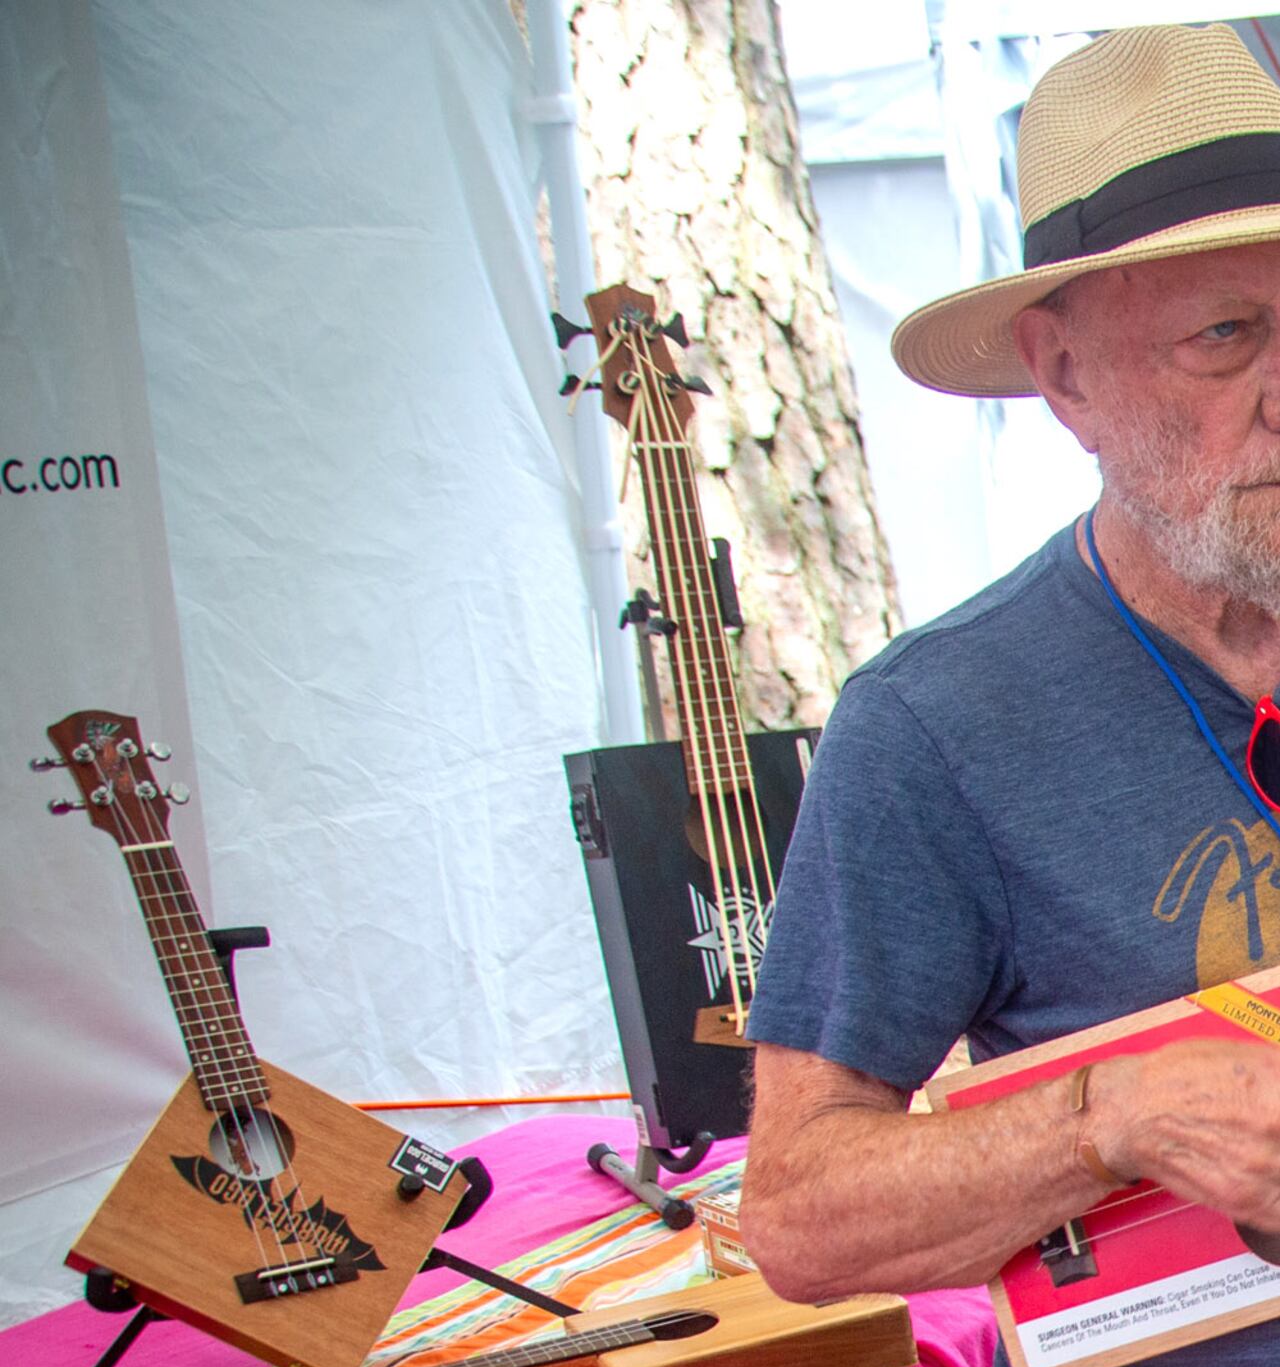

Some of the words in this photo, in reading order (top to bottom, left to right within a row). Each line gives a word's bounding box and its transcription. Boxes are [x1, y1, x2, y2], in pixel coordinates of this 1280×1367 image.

[0, 454, 119, 494] c.com
[1222, 1003, 1276, 1038] LIMITED
[1038, 1322, 1079, 1343] SURGEON
[1080, 1312, 1118, 1330] GENERAL
[1167, 1288, 1189, 1304] Cigar
[1190, 1278, 1226, 1297] Smoking
[1226, 1271, 1243, 1284] Can
[1244, 1264, 1270, 1280] Cause
[1041, 1337, 1075, 1353] Cancers
[1076, 1332, 1087, 1343] Of
[1087, 1328, 1102, 1340] The
[1104, 1318, 1131, 1334] Mouth
[1132, 1312, 1149, 1325] And
[1181, 1296, 1201, 1311] Even
[1211, 1287, 1225, 1300] You
[1226, 1283, 1239, 1295] Do
[1240, 1278, 1256, 1291] Not
